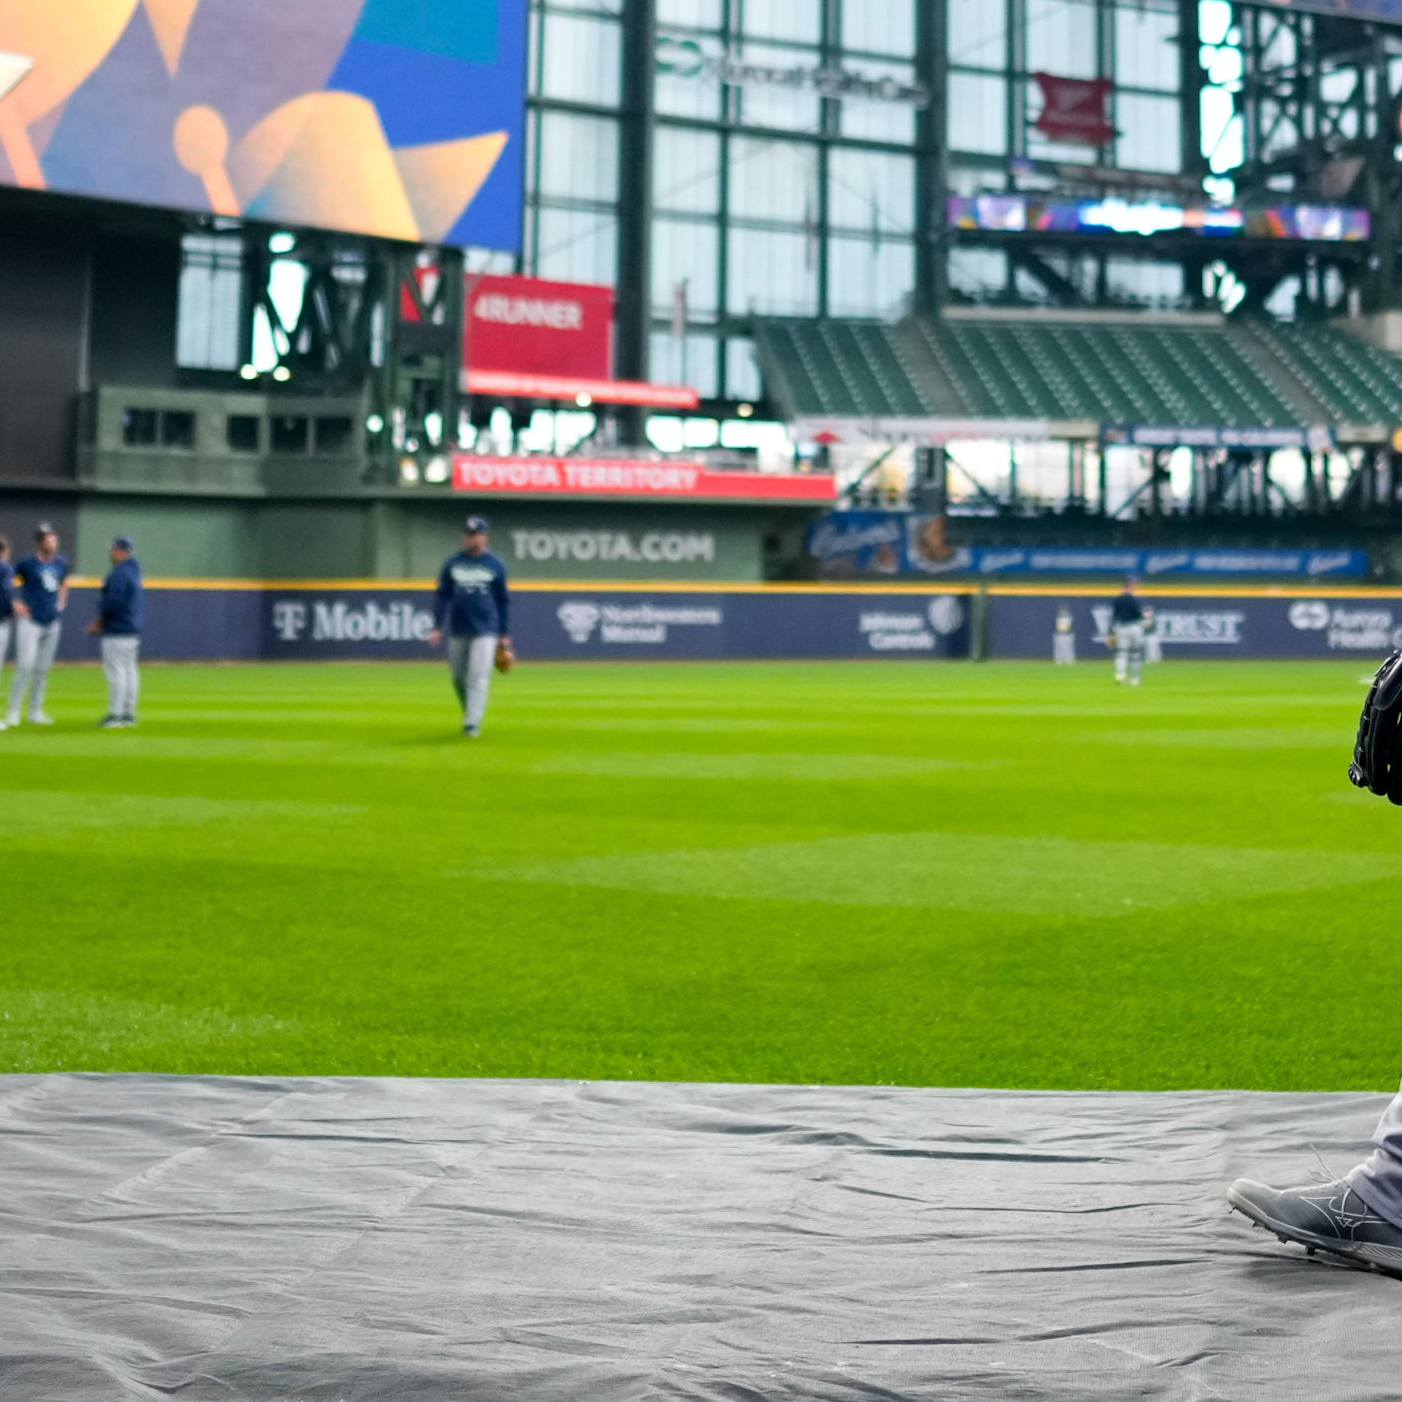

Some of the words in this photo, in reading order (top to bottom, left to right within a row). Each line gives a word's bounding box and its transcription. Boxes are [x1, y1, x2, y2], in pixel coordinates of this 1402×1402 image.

[474, 293, 584, 330] 4RUNNER
[459, 462, 561, 487] TOYOTA
[565, 464, 699, 490] TERRITORY
[510, 530, 716, 563] TOYOTA.COM
[312, 601, 435, 642] Mobile
